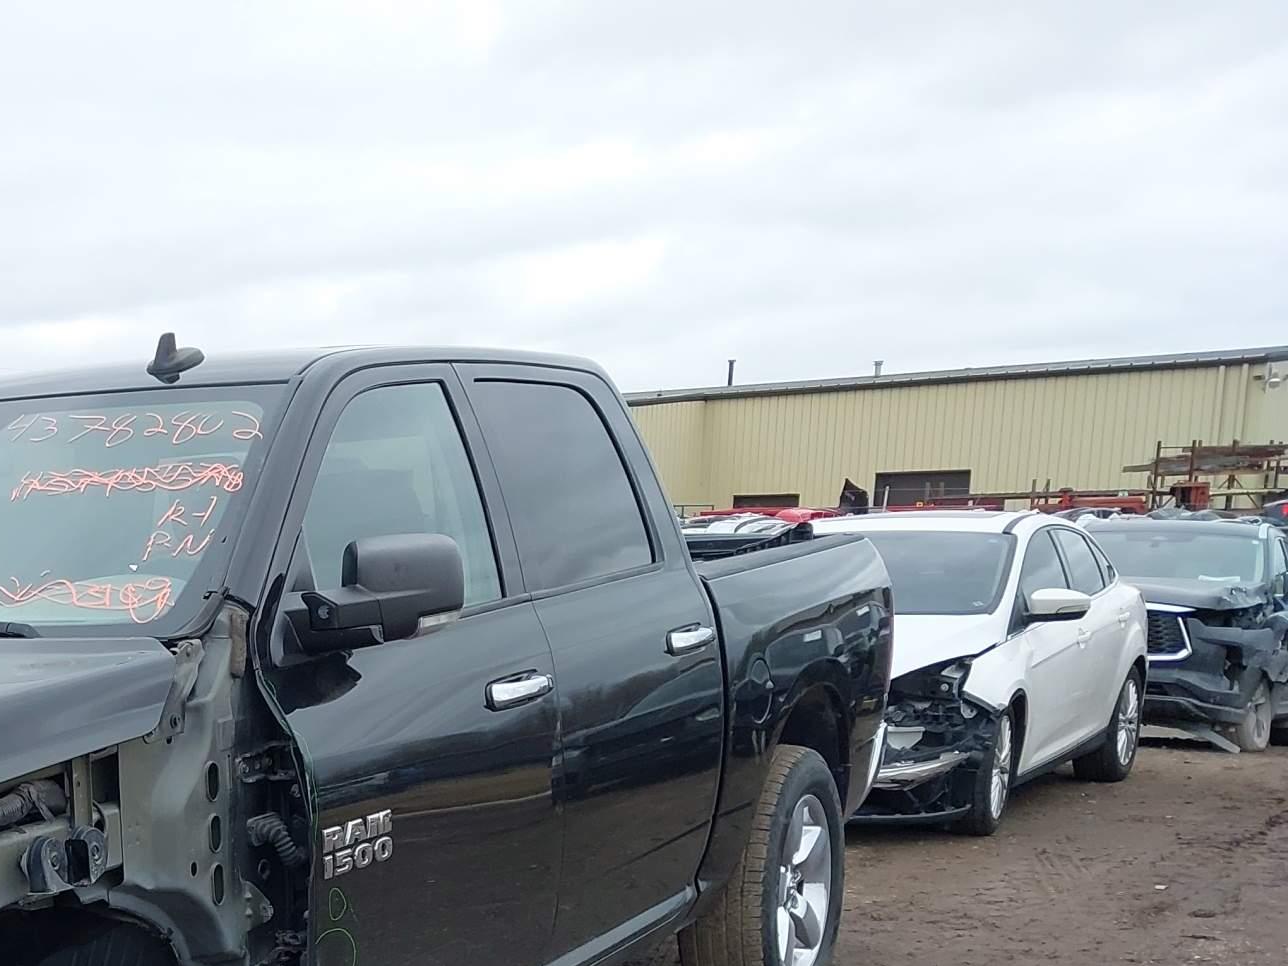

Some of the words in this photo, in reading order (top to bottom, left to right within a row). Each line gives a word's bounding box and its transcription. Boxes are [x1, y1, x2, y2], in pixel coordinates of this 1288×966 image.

[8, 411, 263, 447] 43782802
[322, 809, 392, 855] RAM
[323, 836, 393, 880] 1500
